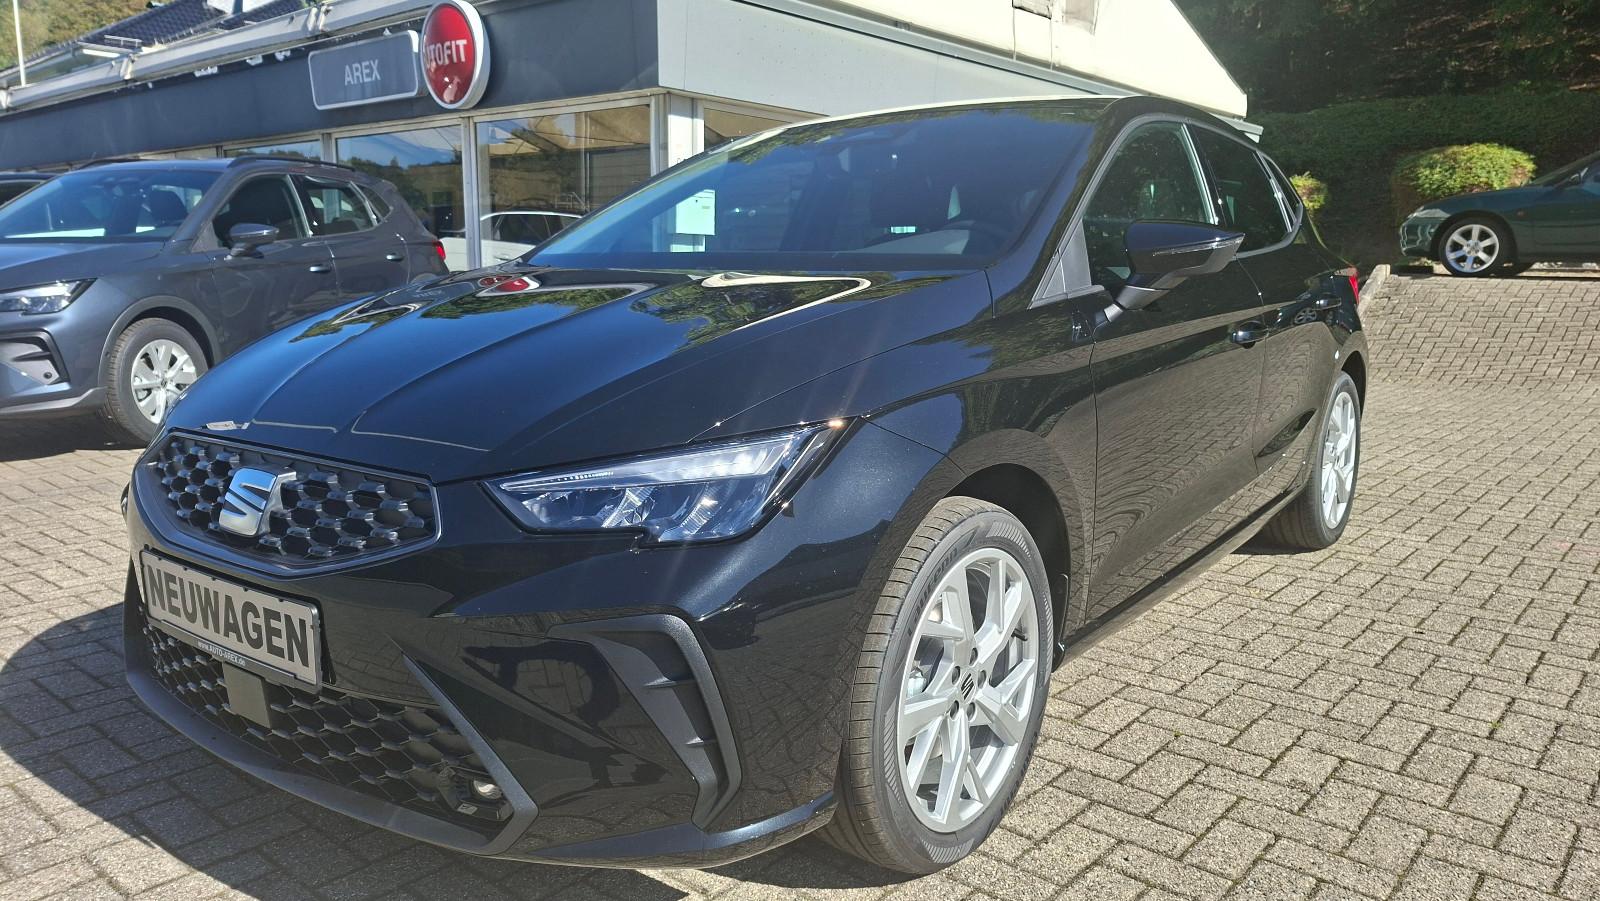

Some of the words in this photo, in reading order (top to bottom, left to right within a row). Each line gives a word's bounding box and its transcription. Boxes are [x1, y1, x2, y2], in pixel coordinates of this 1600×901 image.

[424, 39, 467, 68] UTOFIT
[344, 59, 381, 86] AREX
[147, 565, 309, 667] NEUWAGEN
